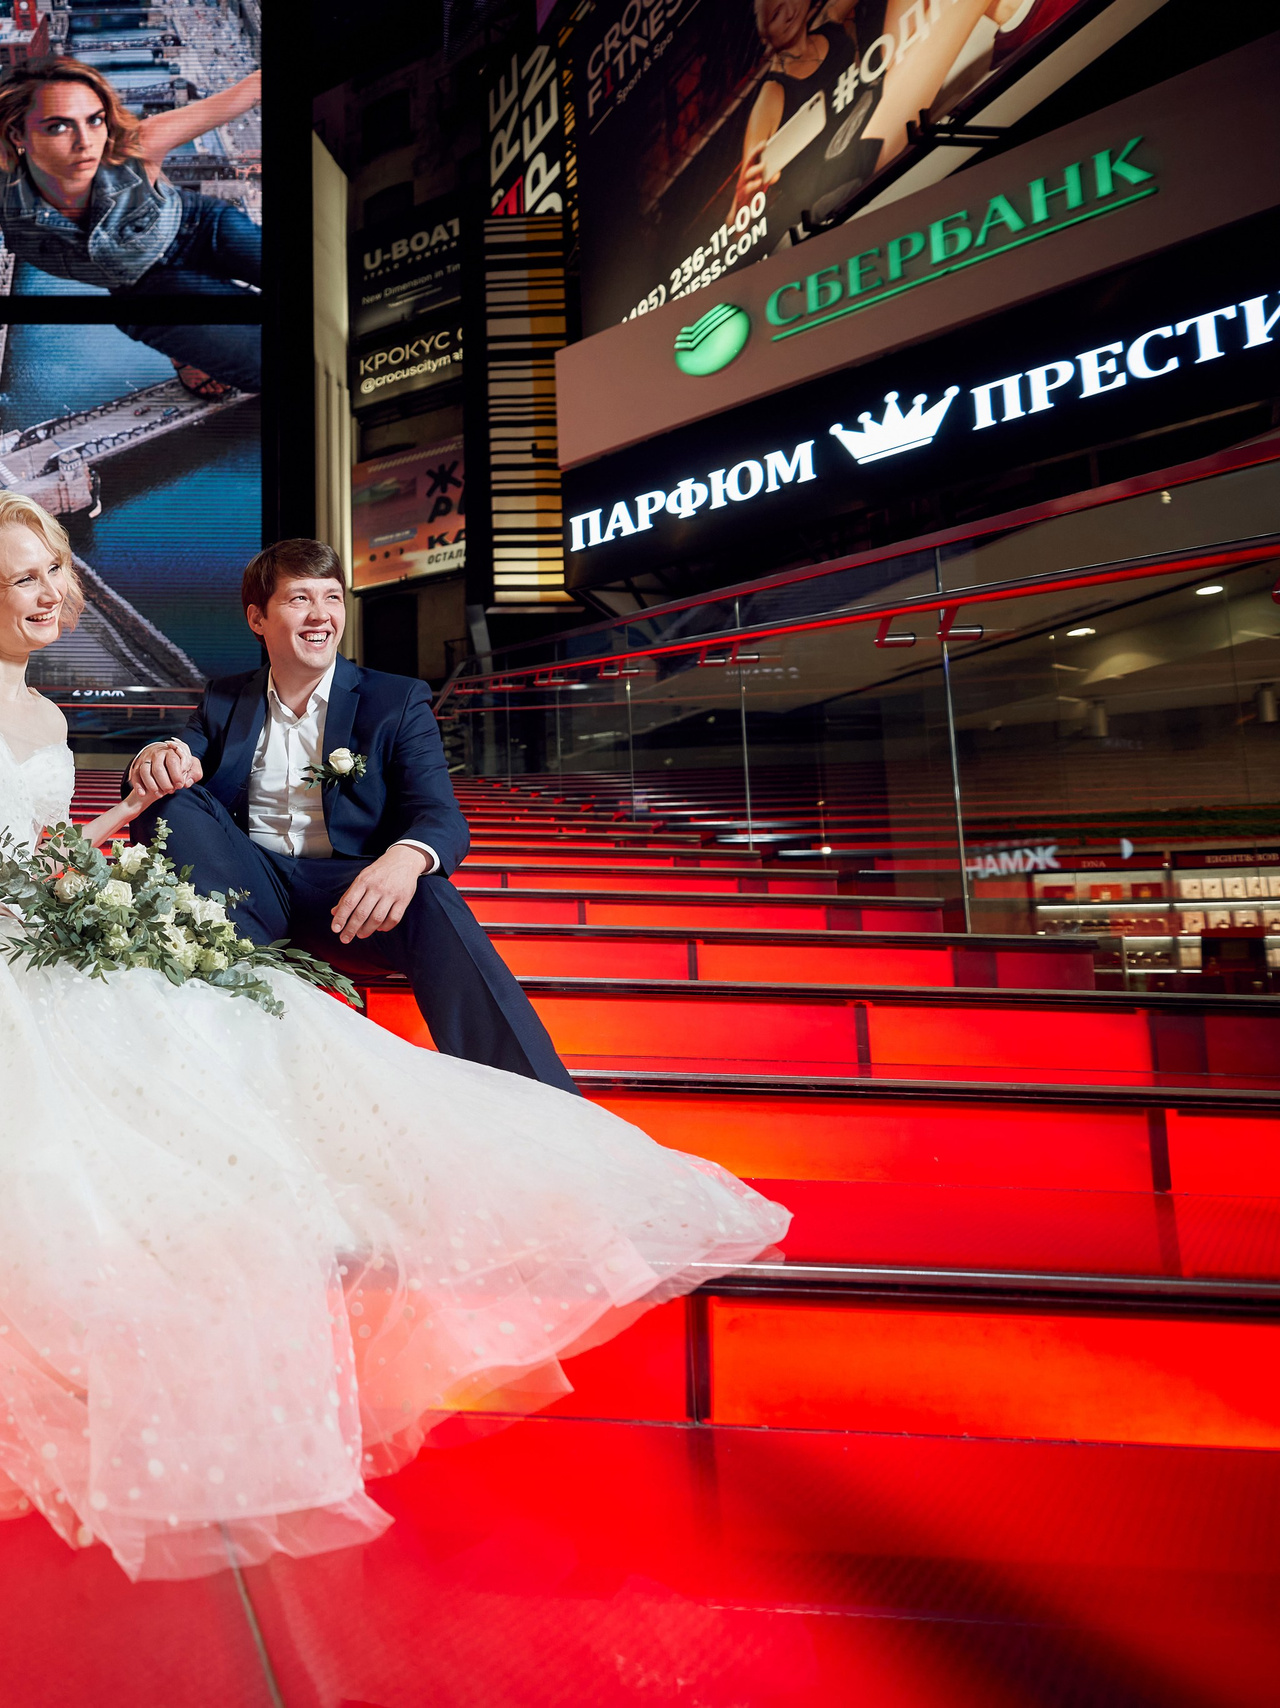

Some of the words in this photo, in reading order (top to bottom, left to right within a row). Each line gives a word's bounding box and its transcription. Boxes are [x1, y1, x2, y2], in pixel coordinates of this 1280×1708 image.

[587, 0, 656, 81] CRO
[670, 191, 766, 295] 236-11-00
[765, 135, 1154, 327] СБЕРБАНК
[359, 331, 451, 376] КРОКУС
[570, 440, 817, 552] ПАРФЮМ
[970, 292, 1280, 431] ПРЕСТИ
[428, 549, 465, 565] ОСТАЛ
